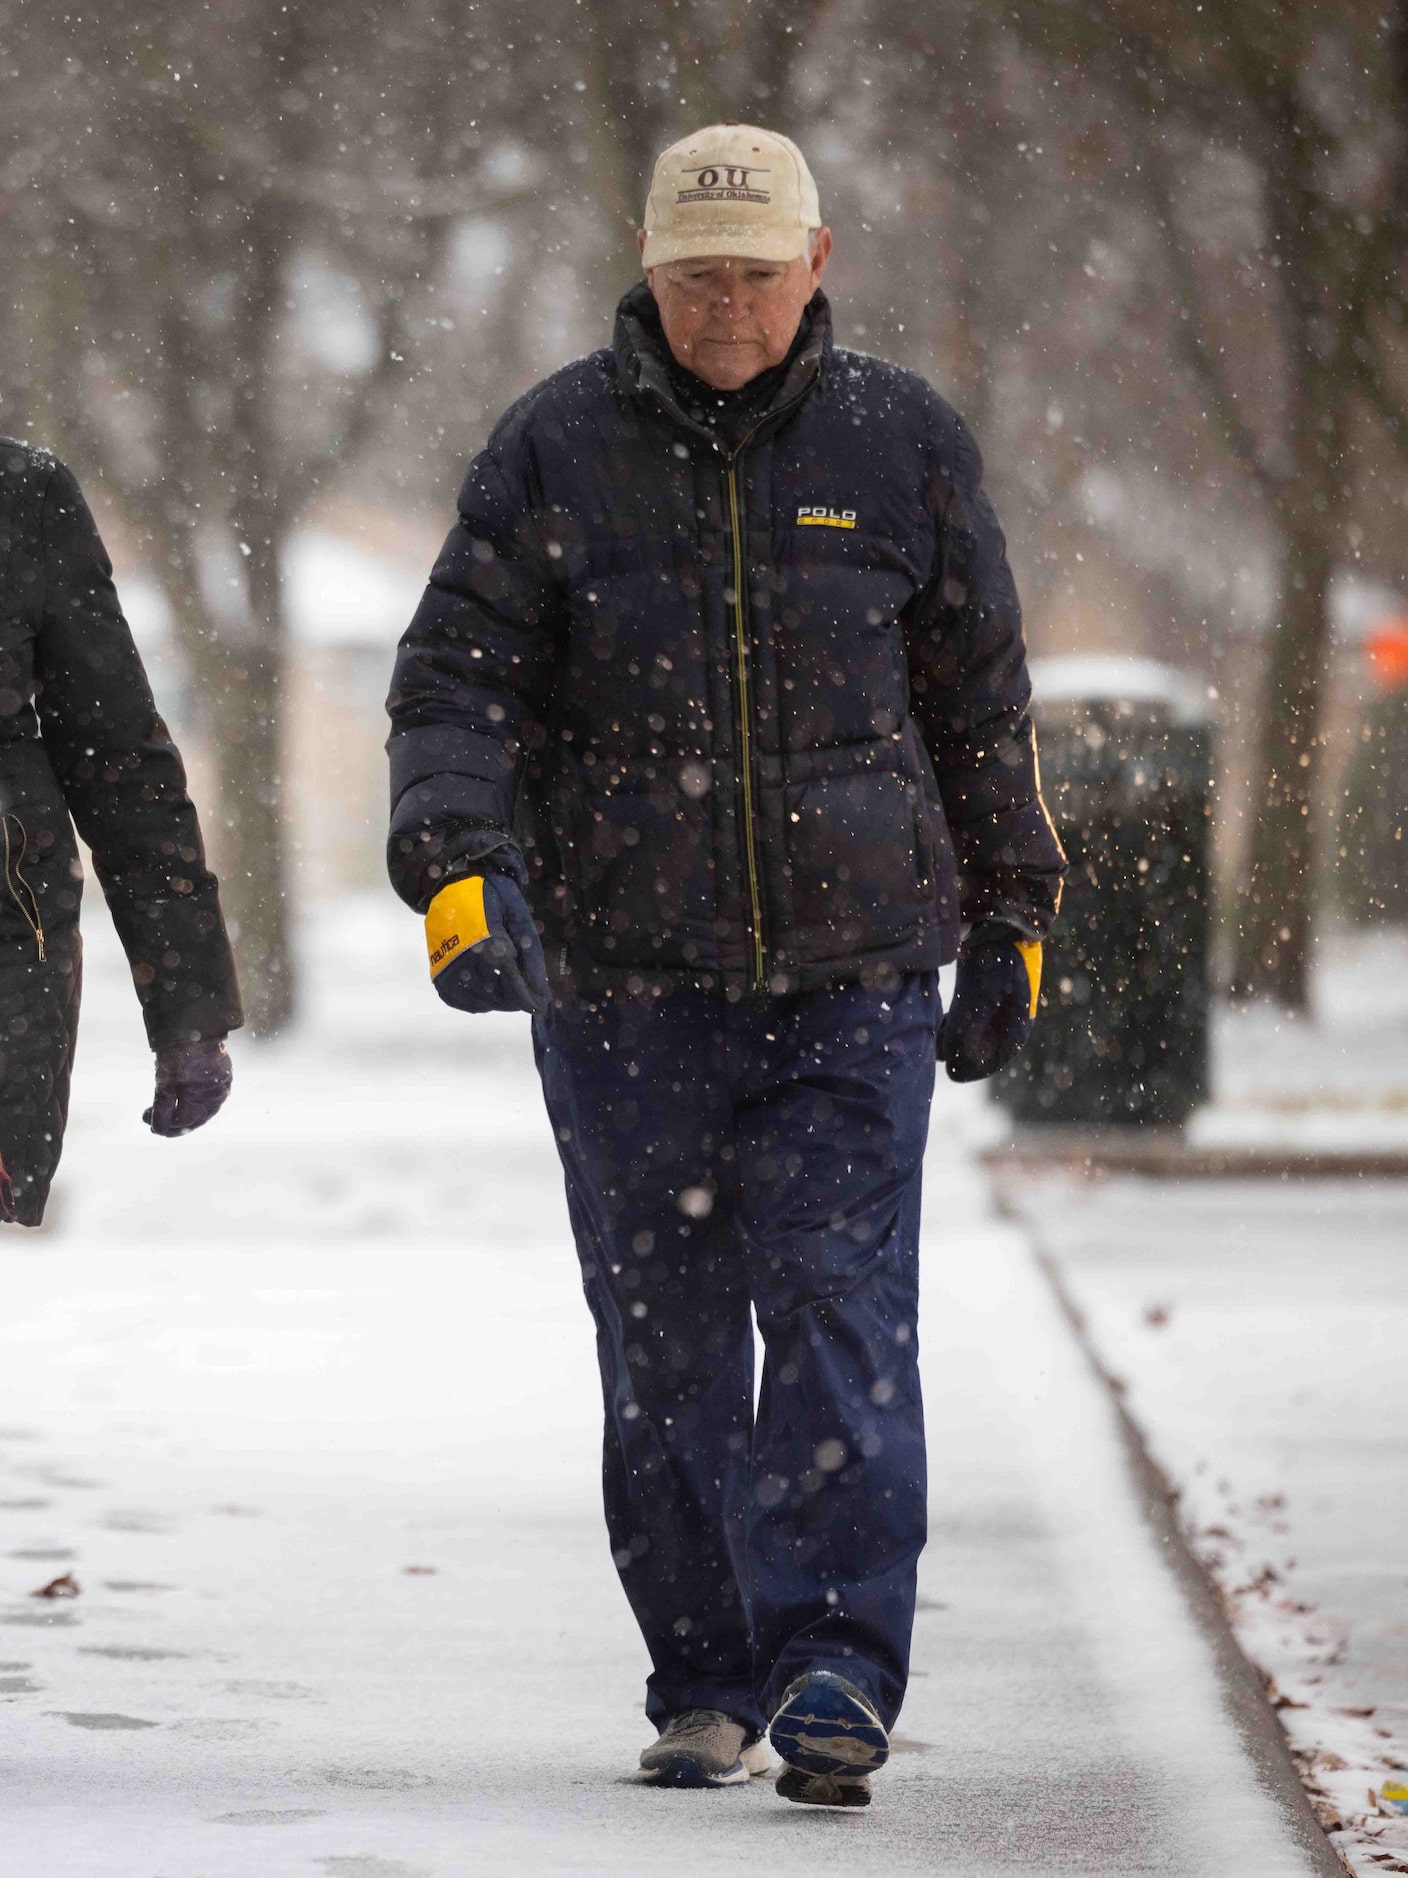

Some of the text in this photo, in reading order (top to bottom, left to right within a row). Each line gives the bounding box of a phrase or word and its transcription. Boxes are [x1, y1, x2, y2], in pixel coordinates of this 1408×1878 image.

[698, 169, 750, 188] OU
[726, 191, 770, 202] Oklahoma
[798, 507, 856, 520] POLO
[798, 518, 854, 528] SPORT
[430, 934, 460, 967] nautica
